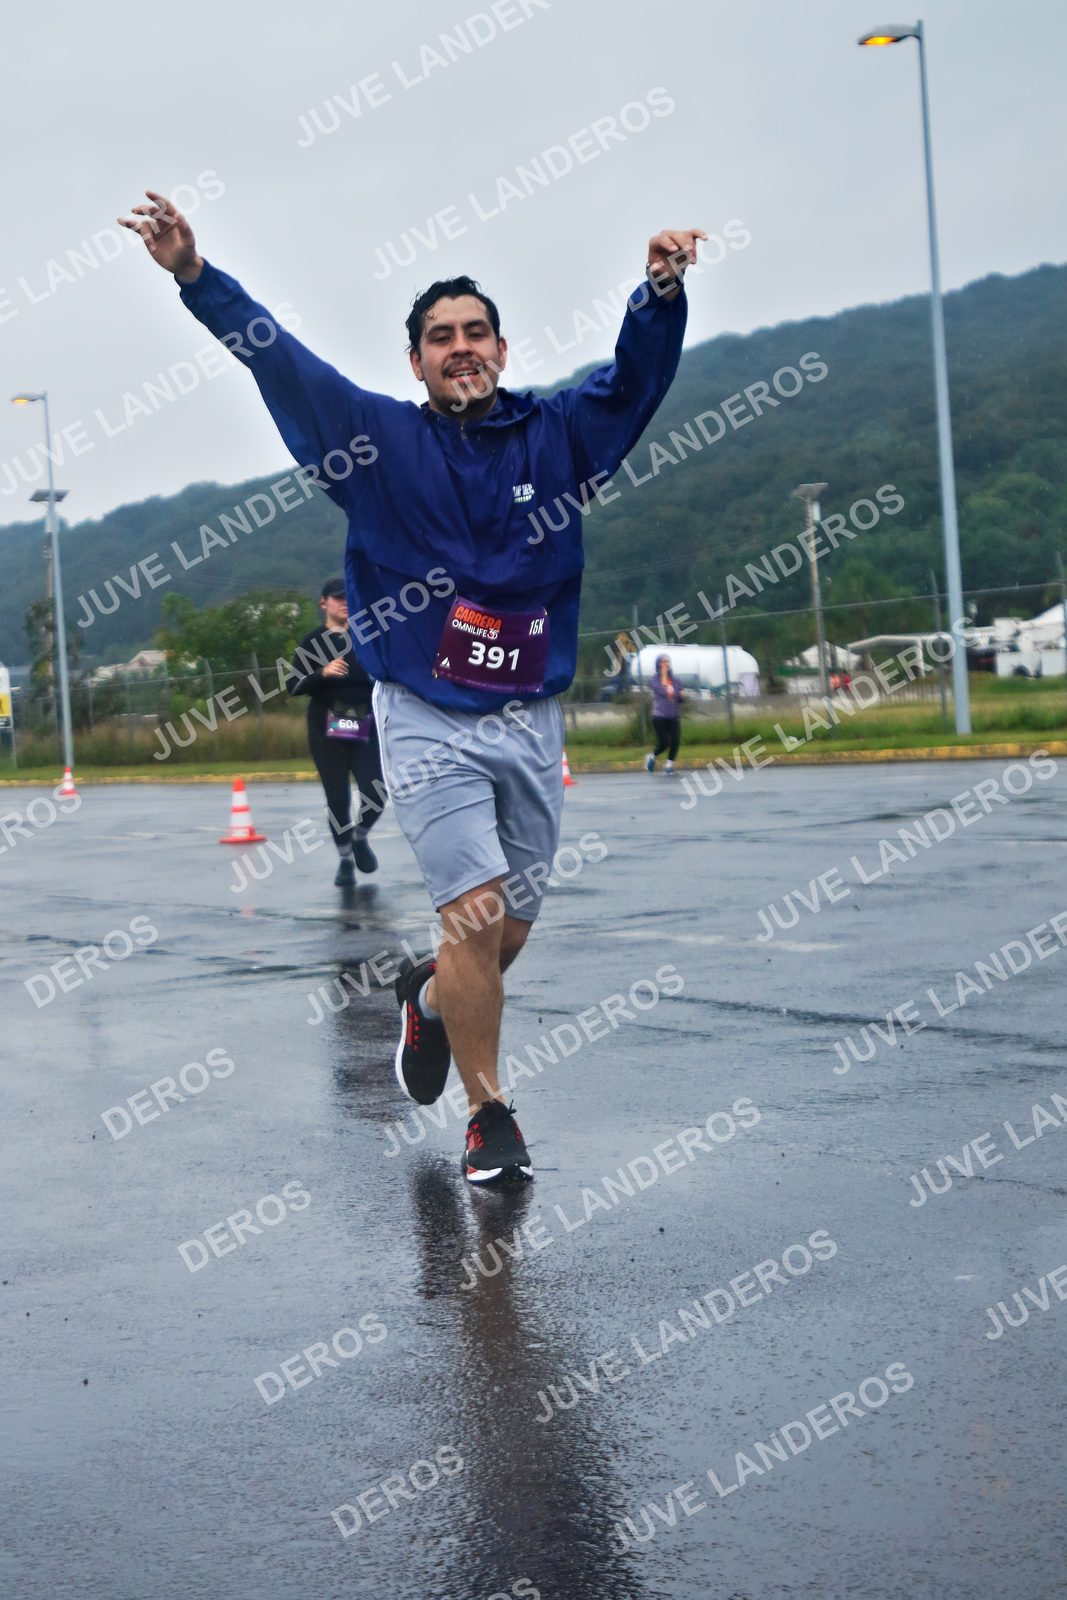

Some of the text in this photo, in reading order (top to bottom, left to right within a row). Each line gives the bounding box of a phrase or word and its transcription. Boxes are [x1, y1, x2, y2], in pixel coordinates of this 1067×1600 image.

[452, 619, 488, 638] OMNILIFE
[454, 605, 502, 630] CARRERA
[468, 641, 520, 671] 391
